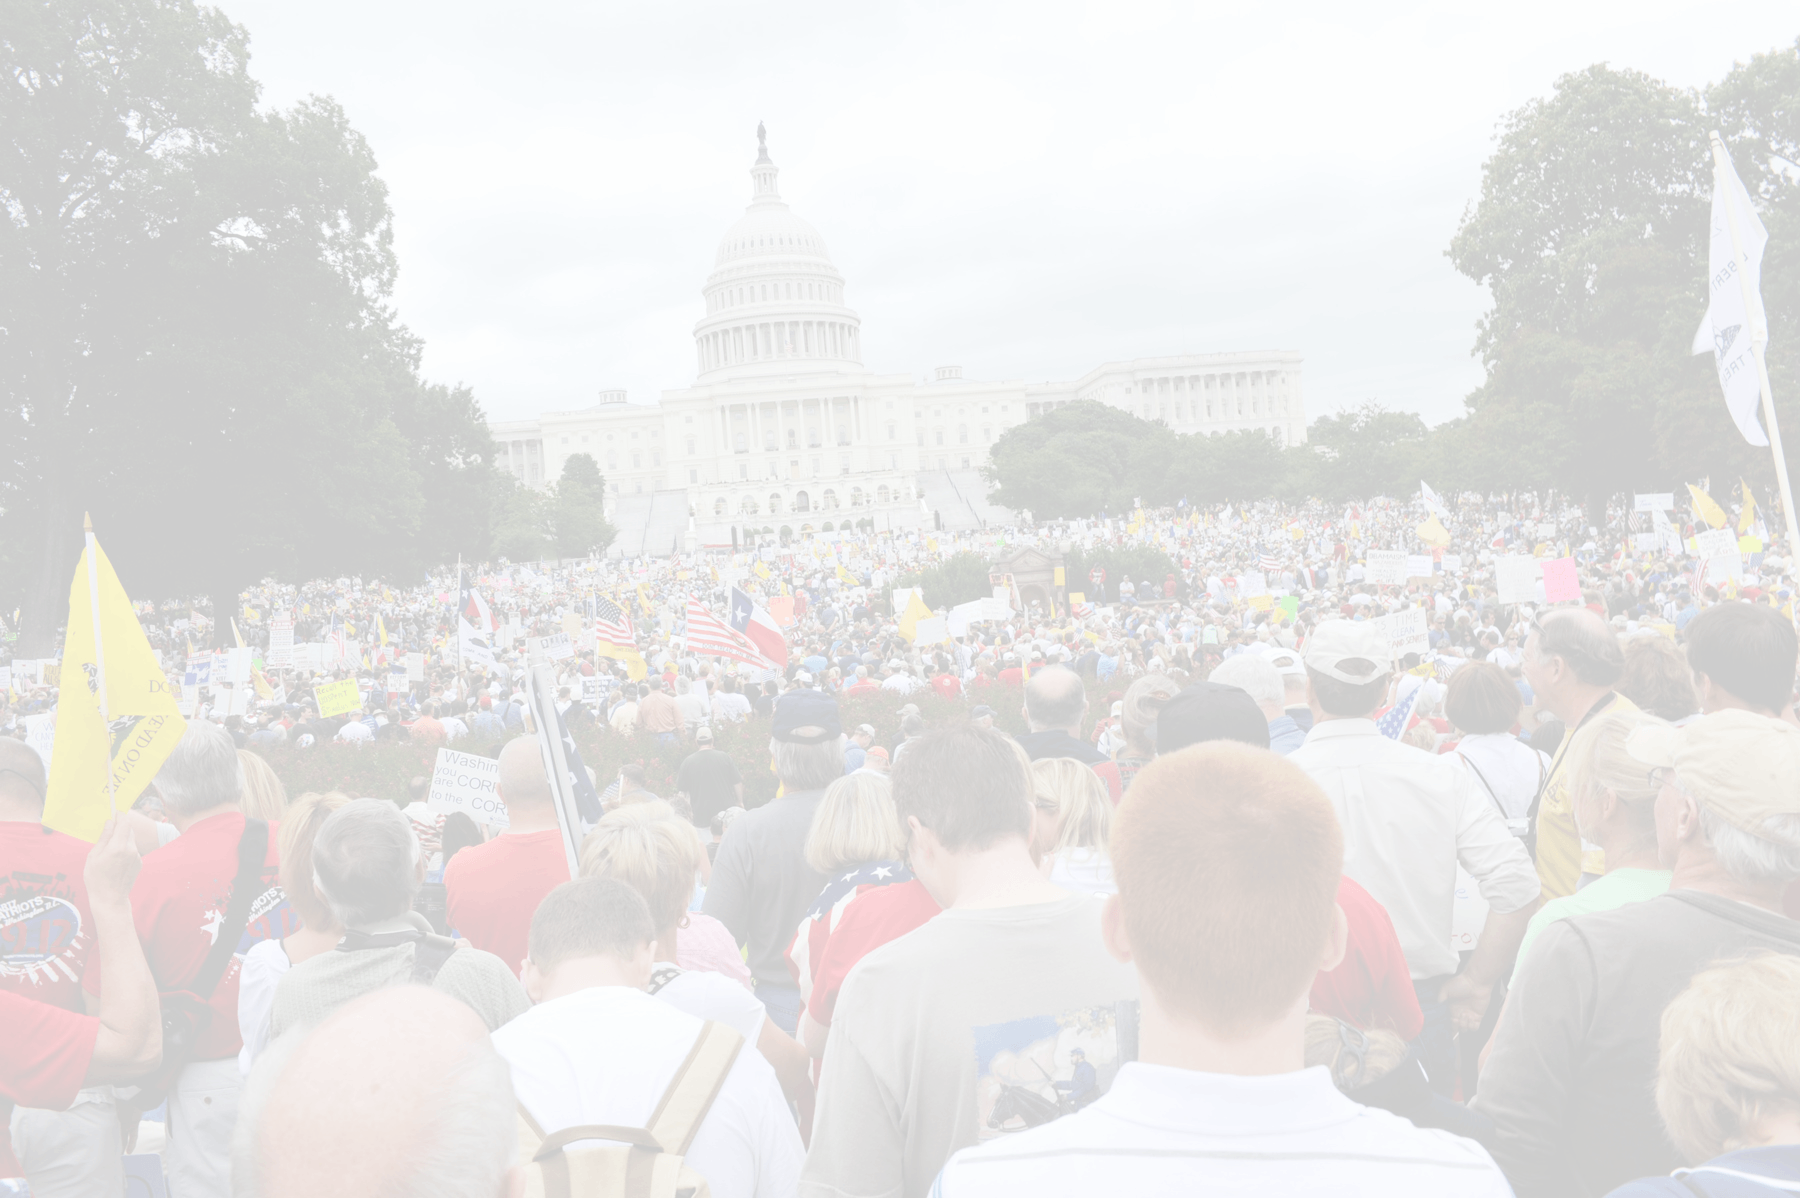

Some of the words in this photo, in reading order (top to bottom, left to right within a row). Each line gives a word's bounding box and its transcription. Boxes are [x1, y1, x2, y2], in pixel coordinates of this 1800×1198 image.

[1395, 611, 1419, 627] TIME
[1391, 625, 1415, 639] CLEAN
[434, 766, 457, 777] you
[434, 777, 454, 788] are
[431, 789, 442, 800] to
[444, 792, 463, 805] the
[1, 918, 72, 955] 9.12
